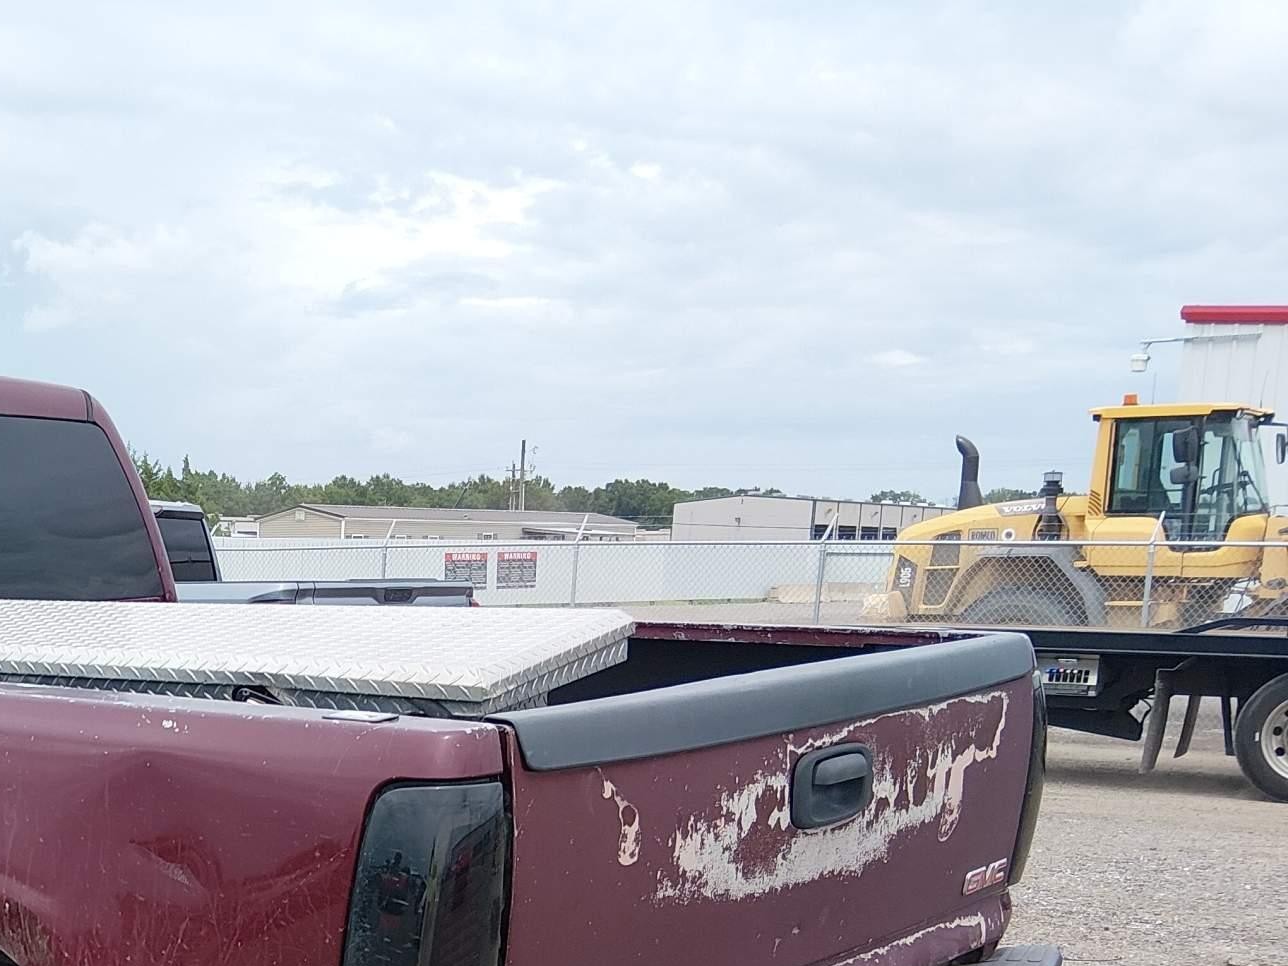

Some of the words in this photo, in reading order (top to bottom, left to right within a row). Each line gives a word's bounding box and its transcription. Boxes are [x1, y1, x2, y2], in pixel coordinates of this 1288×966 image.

[452, 553, 481, 561] WARNING
[504, 552, 531, 560] WARNING
[961, 857, 1008, 897] GMC
